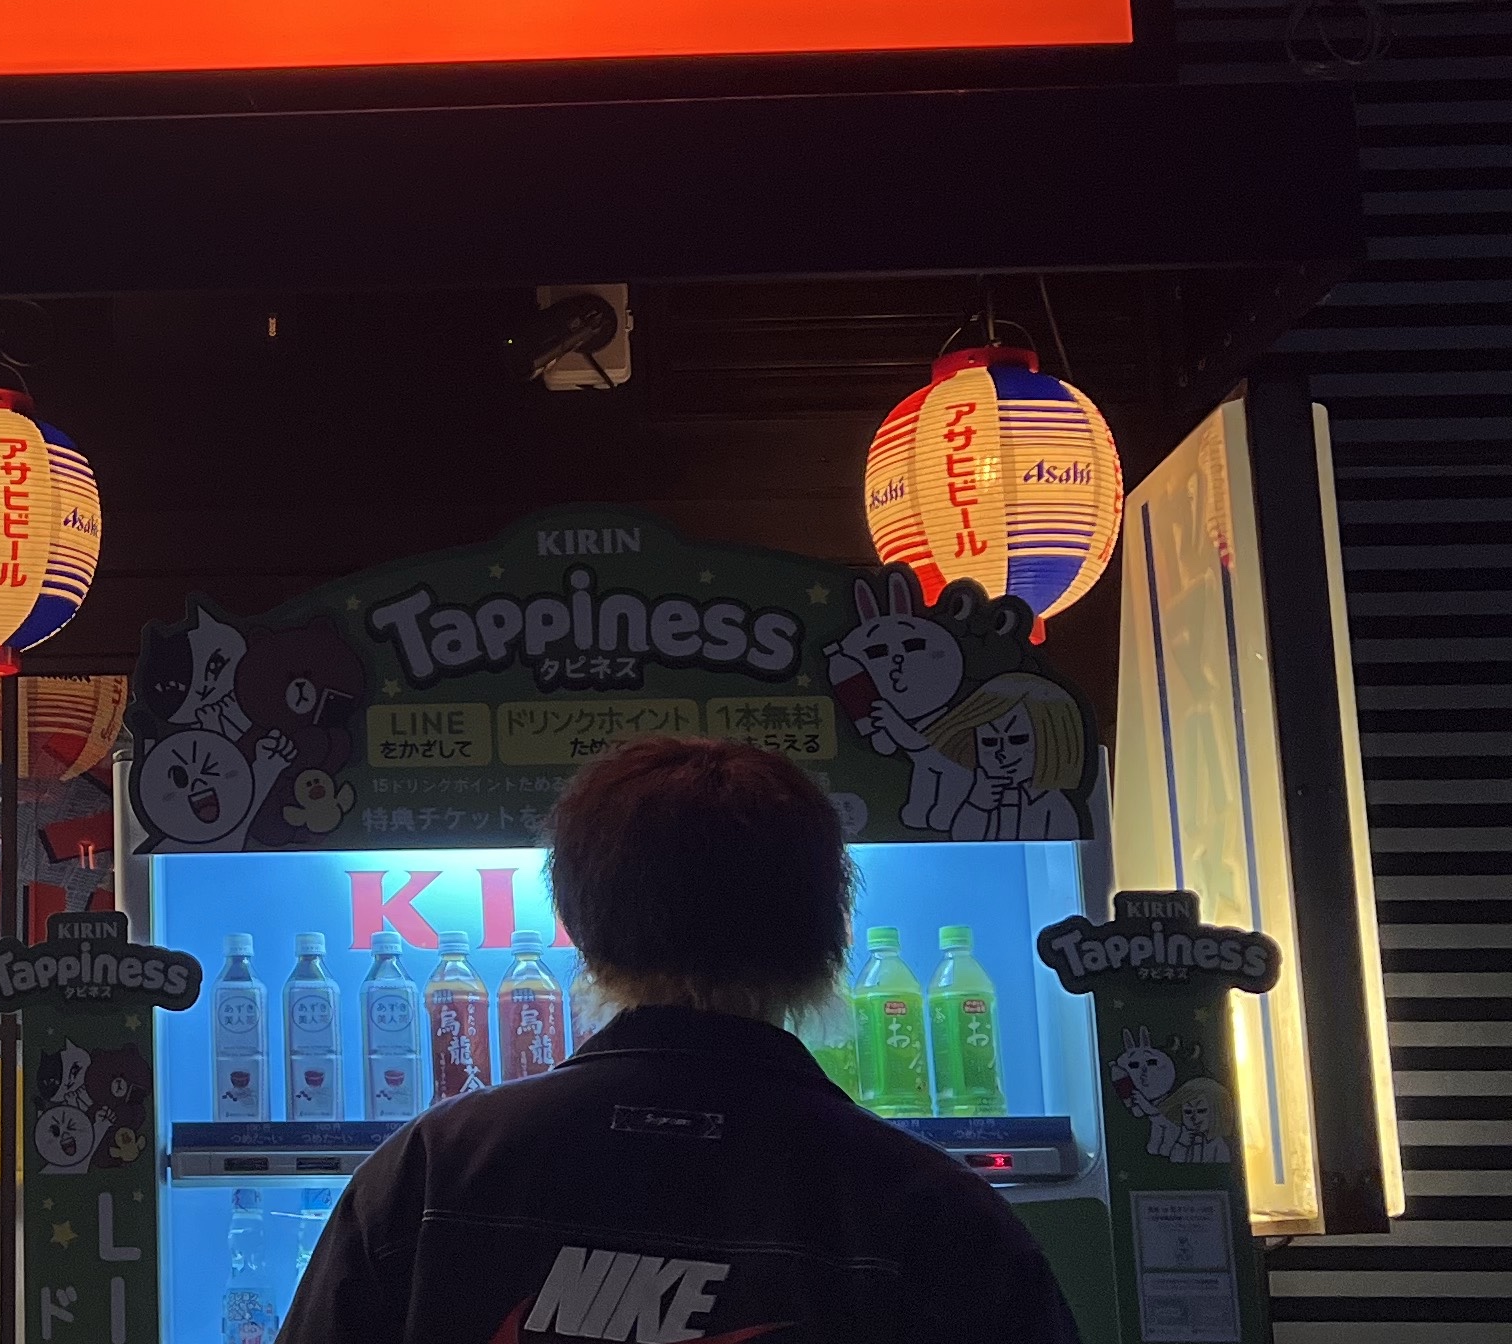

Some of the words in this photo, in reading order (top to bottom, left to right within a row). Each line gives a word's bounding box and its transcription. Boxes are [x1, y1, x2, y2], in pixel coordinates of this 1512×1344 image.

[942, 401, 988, 559] アサヒビール
[1022, 458, 1092, 486] Asahi
[536, 527, 641, 557] KIRIN
[372, 567, 801, 680] Tappiness
[539, 657, 637, 682] タピネス
[390, 710, 465, 736] LINE
[379, 739, 473, 760] をかざして
[345, 868, 576, 950] KI
[1127, 901, 1190, 919] KIRIN
[57, 921, 118, 939] KIRIN
[1051, 921, 1267, 978] Tappiness
